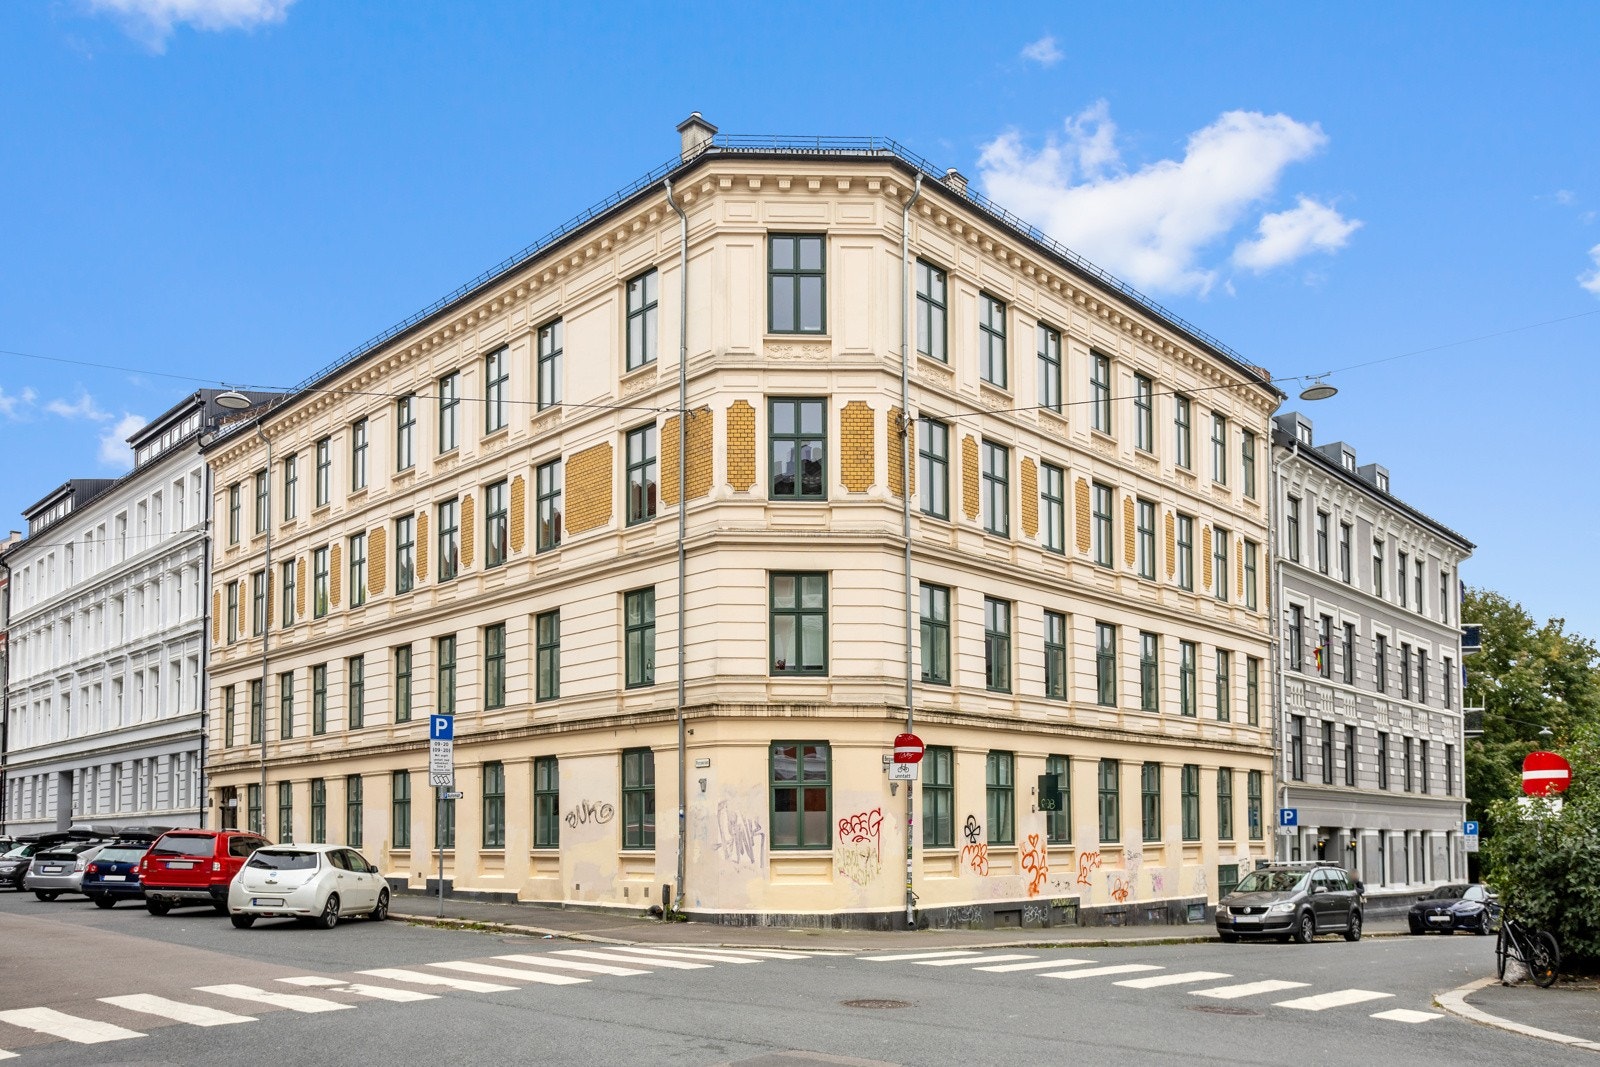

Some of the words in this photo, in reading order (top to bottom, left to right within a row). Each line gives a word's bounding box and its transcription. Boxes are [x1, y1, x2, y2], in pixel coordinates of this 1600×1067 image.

[435, 717, 448, 737] P
[1284, 810, 1294, 824] P
[1466, 823, 1475, 834] P
